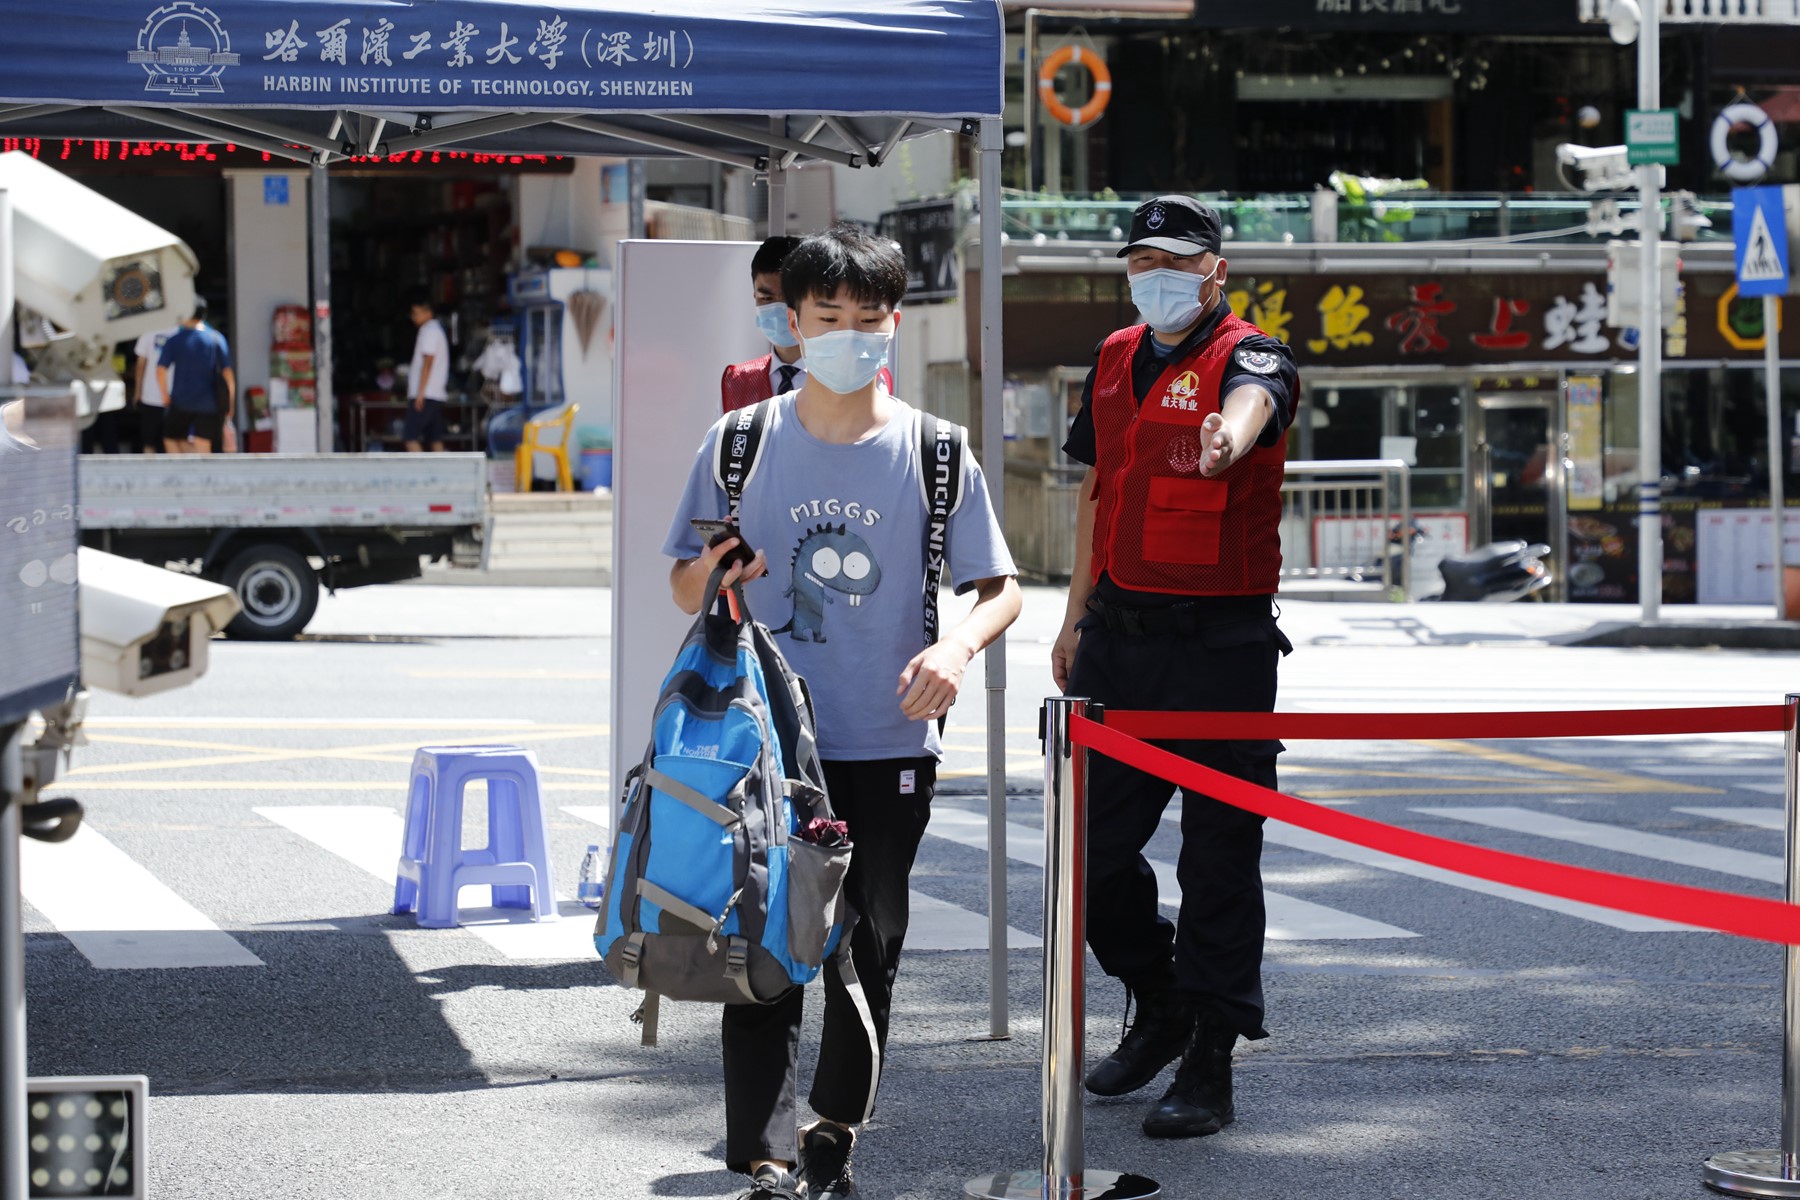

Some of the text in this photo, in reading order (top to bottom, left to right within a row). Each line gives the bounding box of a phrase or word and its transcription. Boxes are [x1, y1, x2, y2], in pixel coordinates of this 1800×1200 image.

[166, 76, 202, 85] HIT
[263, 75, 694, 97] HARBIN INSTITUTE OF TECHNOLOGY, SHENZHEN
[1161, 395, 1198, 411] 航天物业
[789, 498, 882, 527] MIGGS
